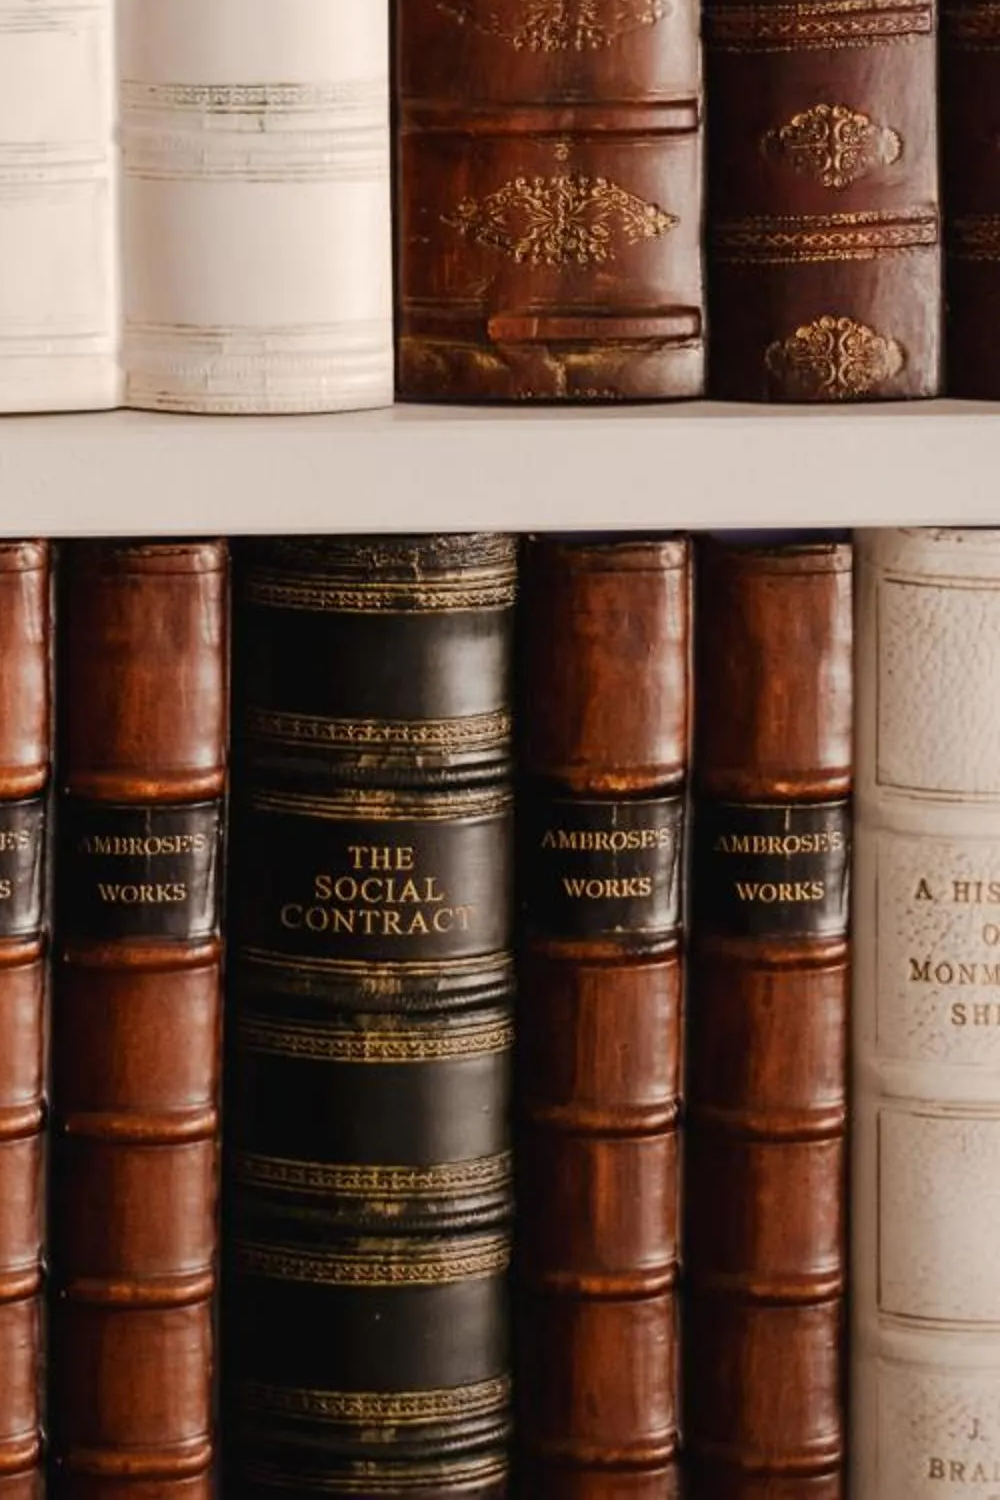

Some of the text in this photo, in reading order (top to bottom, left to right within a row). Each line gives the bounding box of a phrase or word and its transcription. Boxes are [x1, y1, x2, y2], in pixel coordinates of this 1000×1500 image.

[349, 846, 415, 871] THE
[98, 882, 187, 903] WORKS
[315, 875, 444, 903] SOCIAL
[562, 877, 652, 899] WORKS
[736, 880, 825, 903] WORKS
[915, 877, 1000, 904] A HIS
[281, 904, 474, 935] CONTRACT
